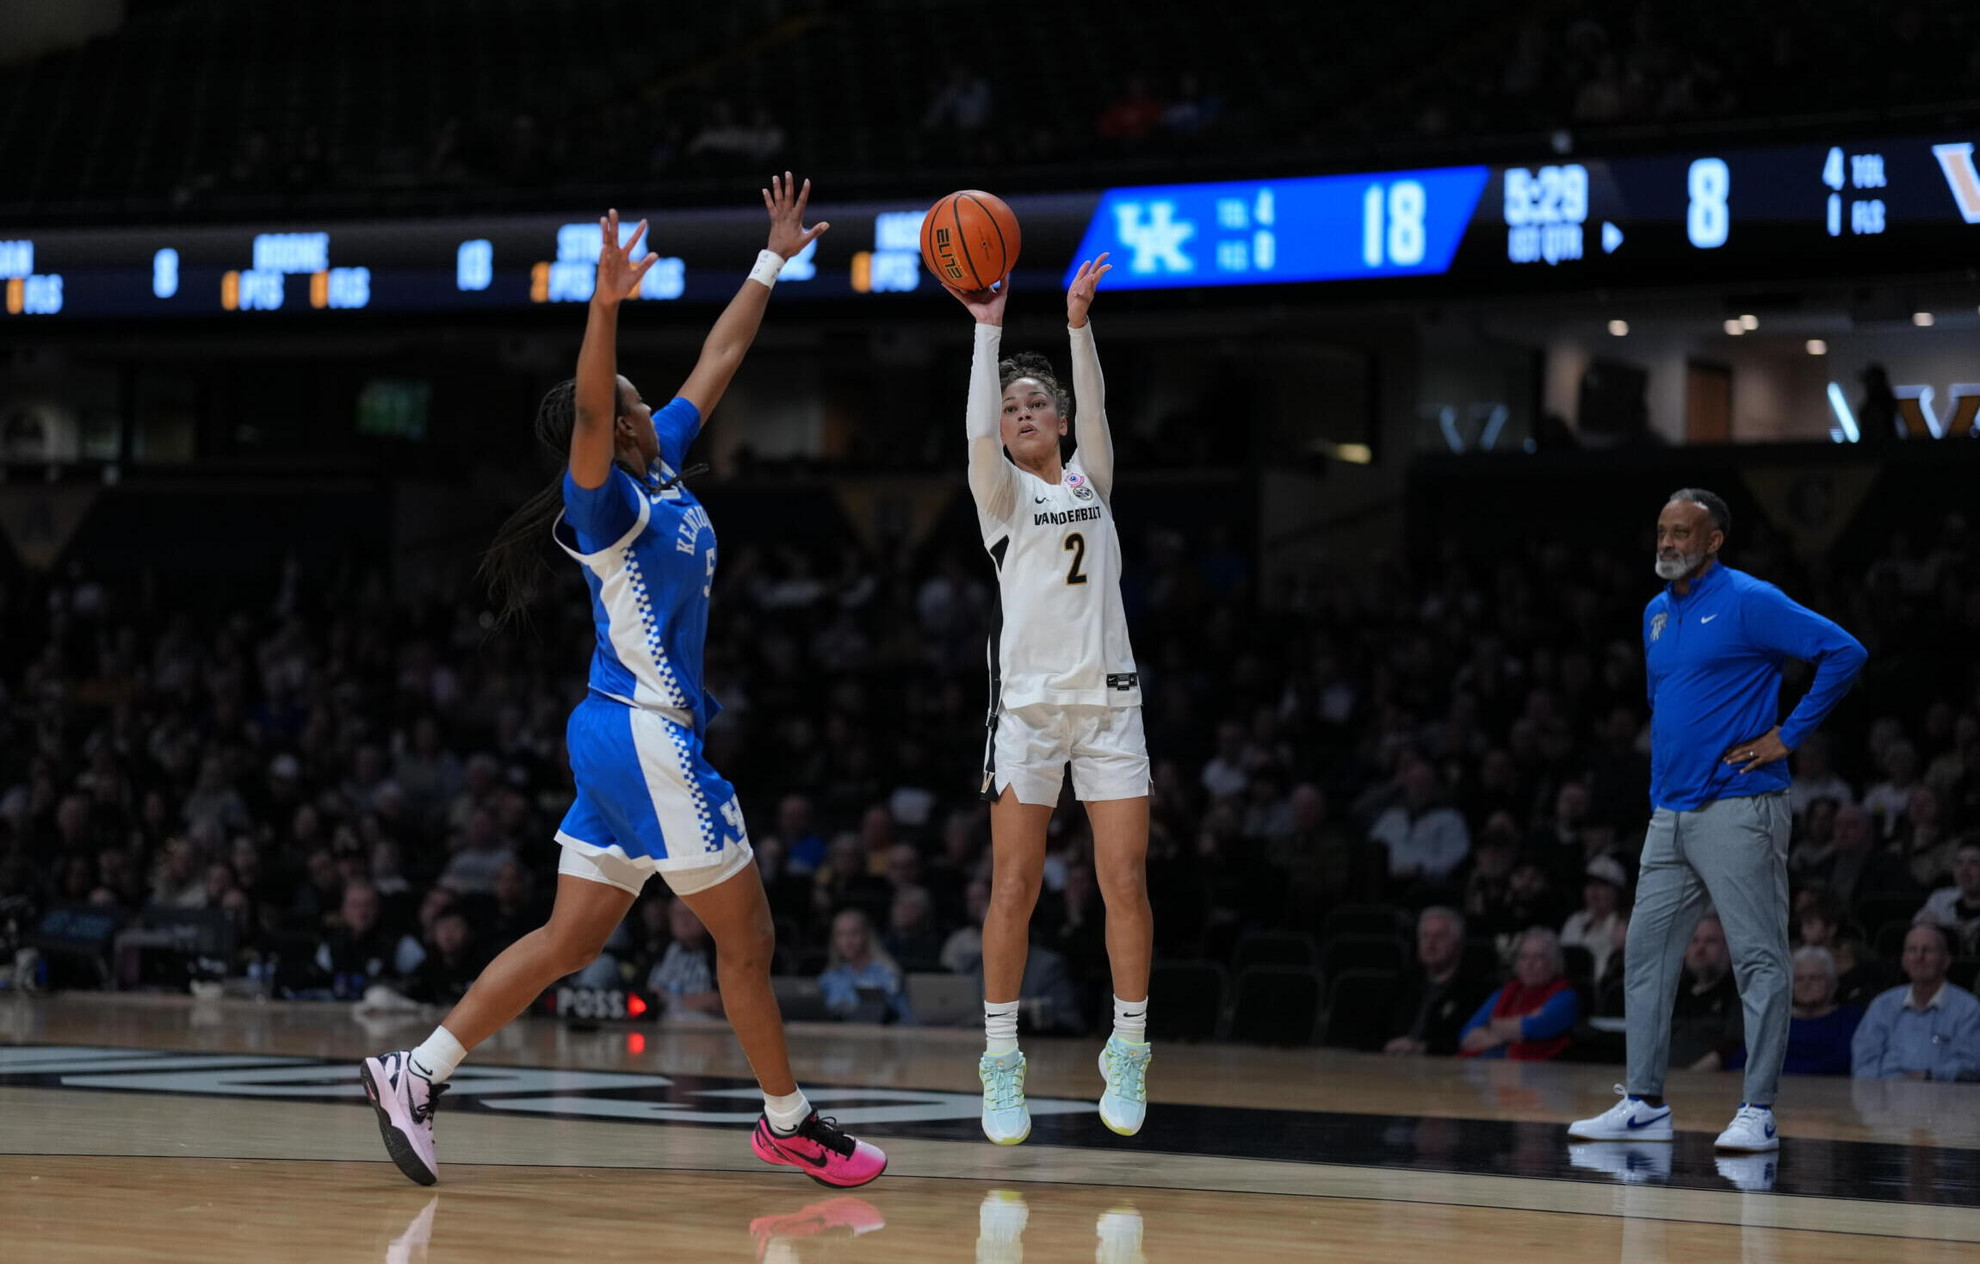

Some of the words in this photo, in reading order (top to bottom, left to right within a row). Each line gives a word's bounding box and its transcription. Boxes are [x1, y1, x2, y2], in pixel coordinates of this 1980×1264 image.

[1504, 164, 1588, 226] 5:29
[1822, 146, 1846, 191] 4
[1364, 180, 1426, 268] 18
[1687, 158, 1730, 249] 8
[936, 228, 963, 279] ELITE
[1113, 202, 1194, 273] UK
[676, 505, 716, 556] KENTU
[1034, 506, 1101, 526] VANDERBILT
[1065, 532, 1087, 586] 2
